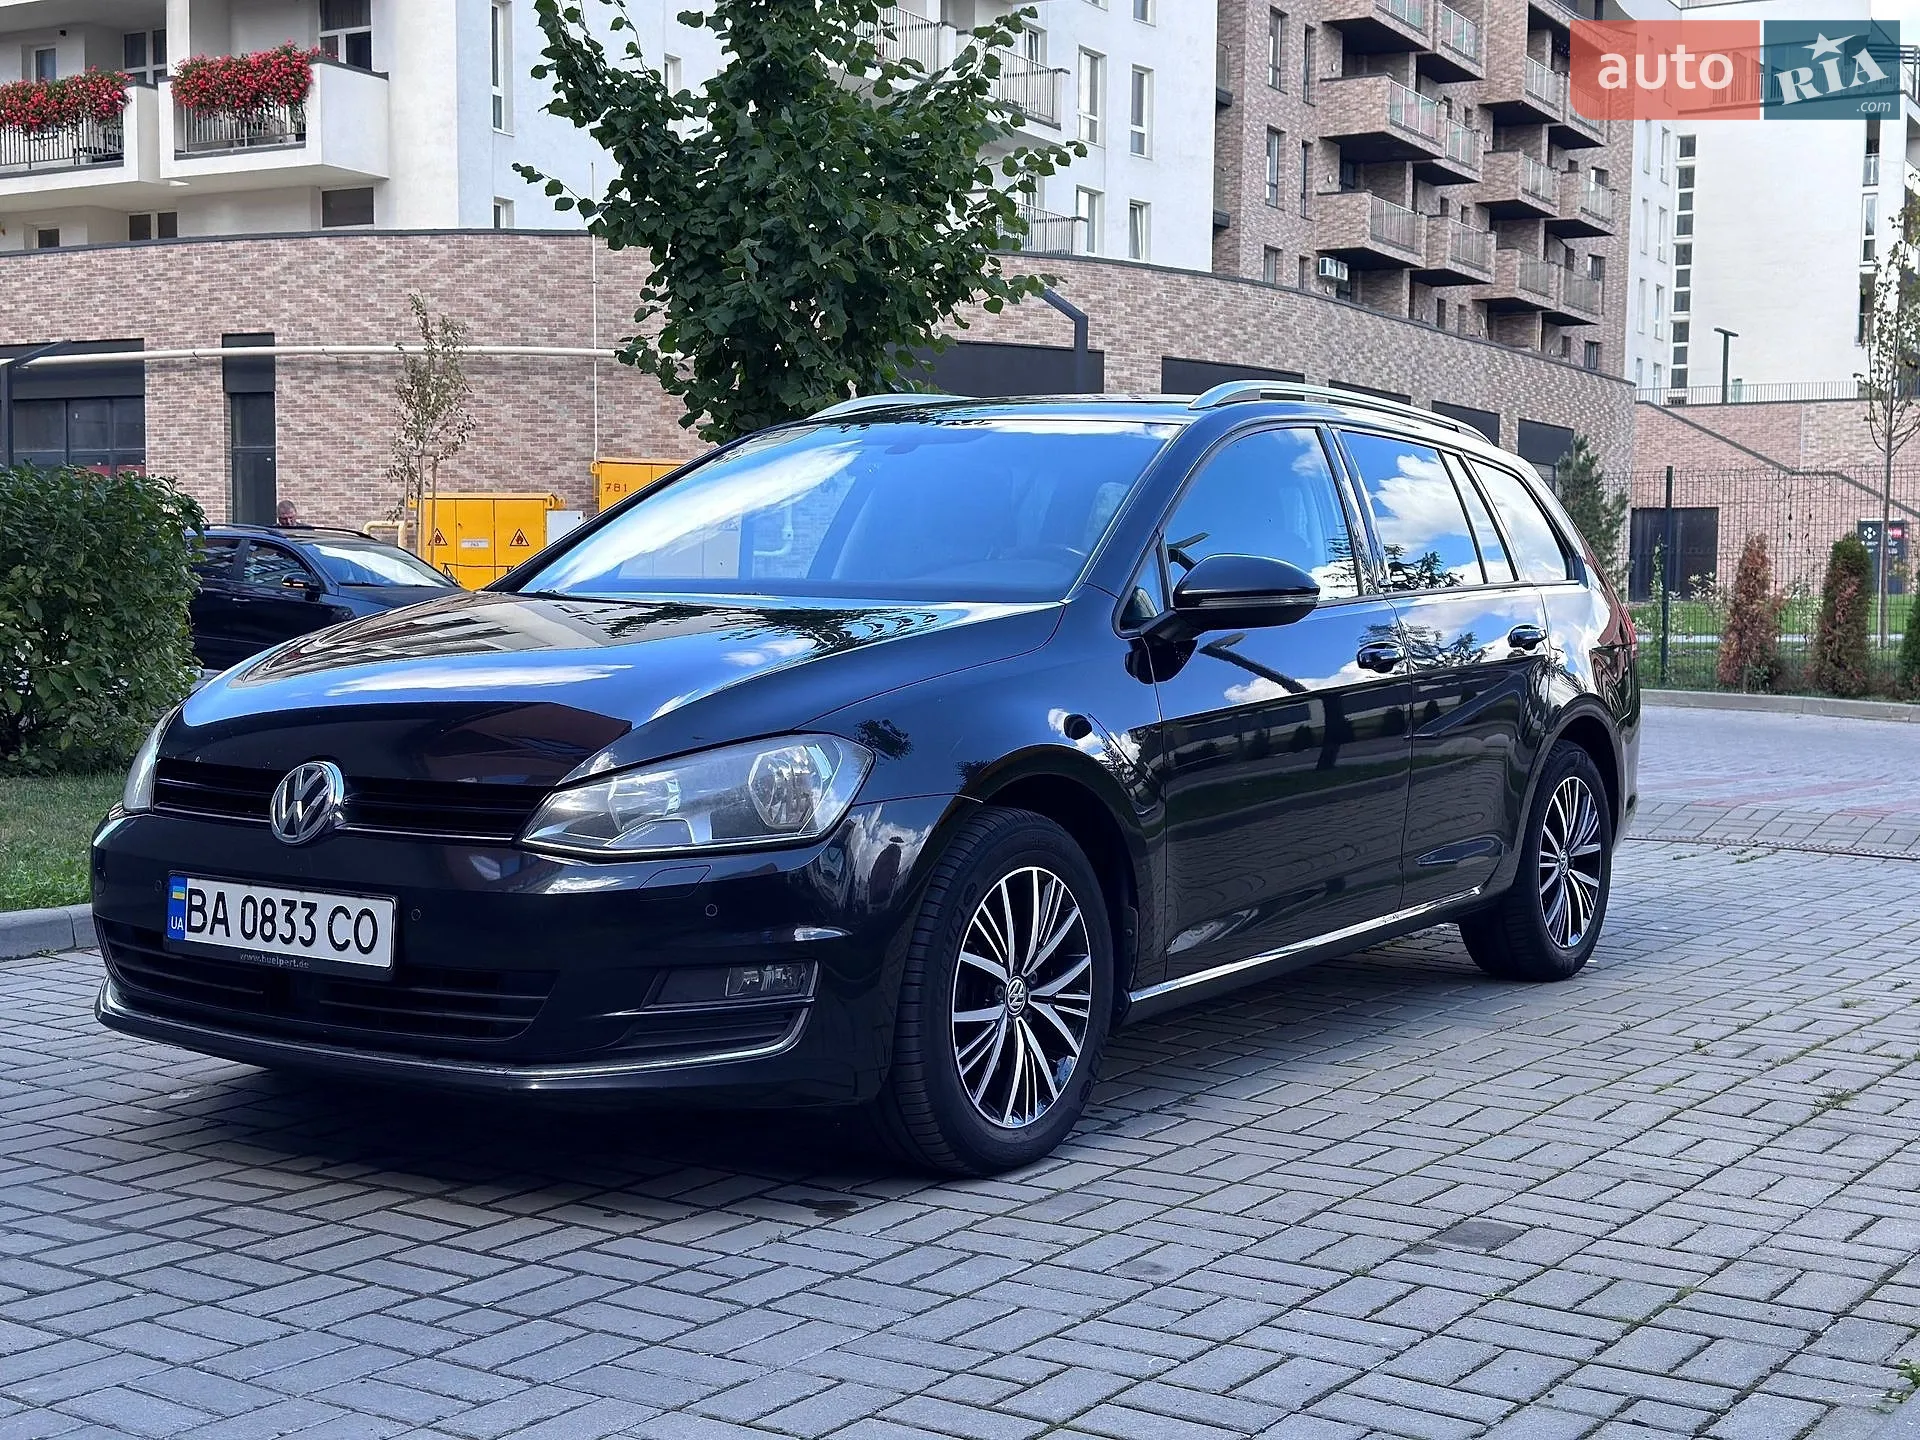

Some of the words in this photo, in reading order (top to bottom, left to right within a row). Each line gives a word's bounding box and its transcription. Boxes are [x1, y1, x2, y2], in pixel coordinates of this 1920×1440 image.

[604, 483, 627, 492] 781
[171, 916, 184, 930] UA
[187, 887, 231, 937] BA
[240, 895, 318, 947] 0833
[327, 905, 379, 955] CO
